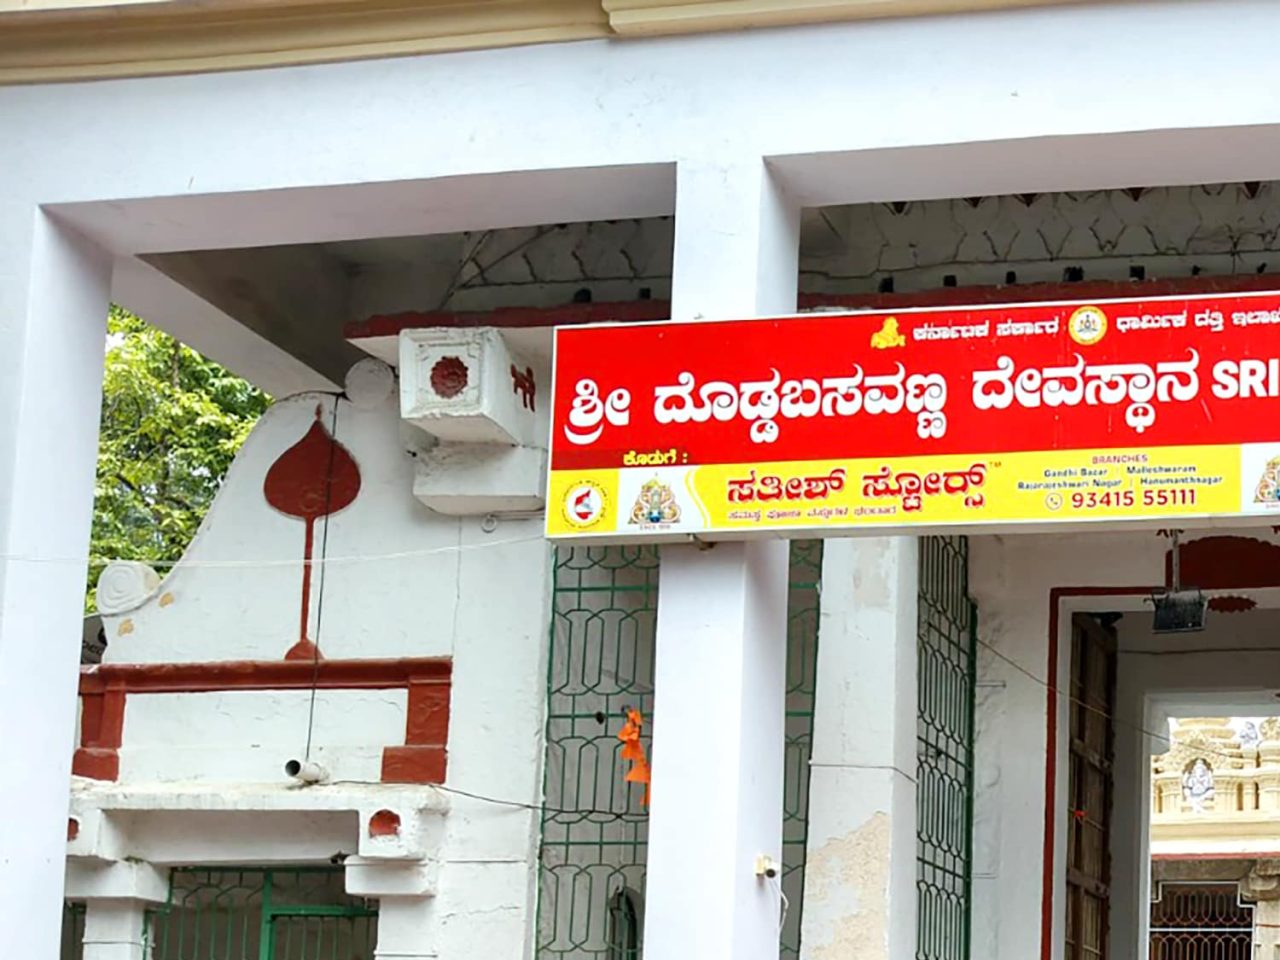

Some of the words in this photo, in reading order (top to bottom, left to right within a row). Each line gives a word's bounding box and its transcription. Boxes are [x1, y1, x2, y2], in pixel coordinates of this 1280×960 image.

[563, 378, 631, 445] ಶ್ರೀ
[653, 361, 949, 443] ದೊಡ್ಡಬಸವಣ್ಣ
[971, 347, 1200, 434] ದೇವಸ್ಥಾನ
[1211, 357, 1280, 399] SRI
[1092, 454, 1148, 465] BRANCHES
[1044, 468, 1077, 478] Gandhi
[1126, 465, 1197, 474] Malleshwaram
[727, 468, 846, 503] ಸತೀಶ್
[1092, 478, 1122, 488] Nagar
[1071, 490, 1135, 509] 93415
[1142, 488, 1196, 506] 55111
